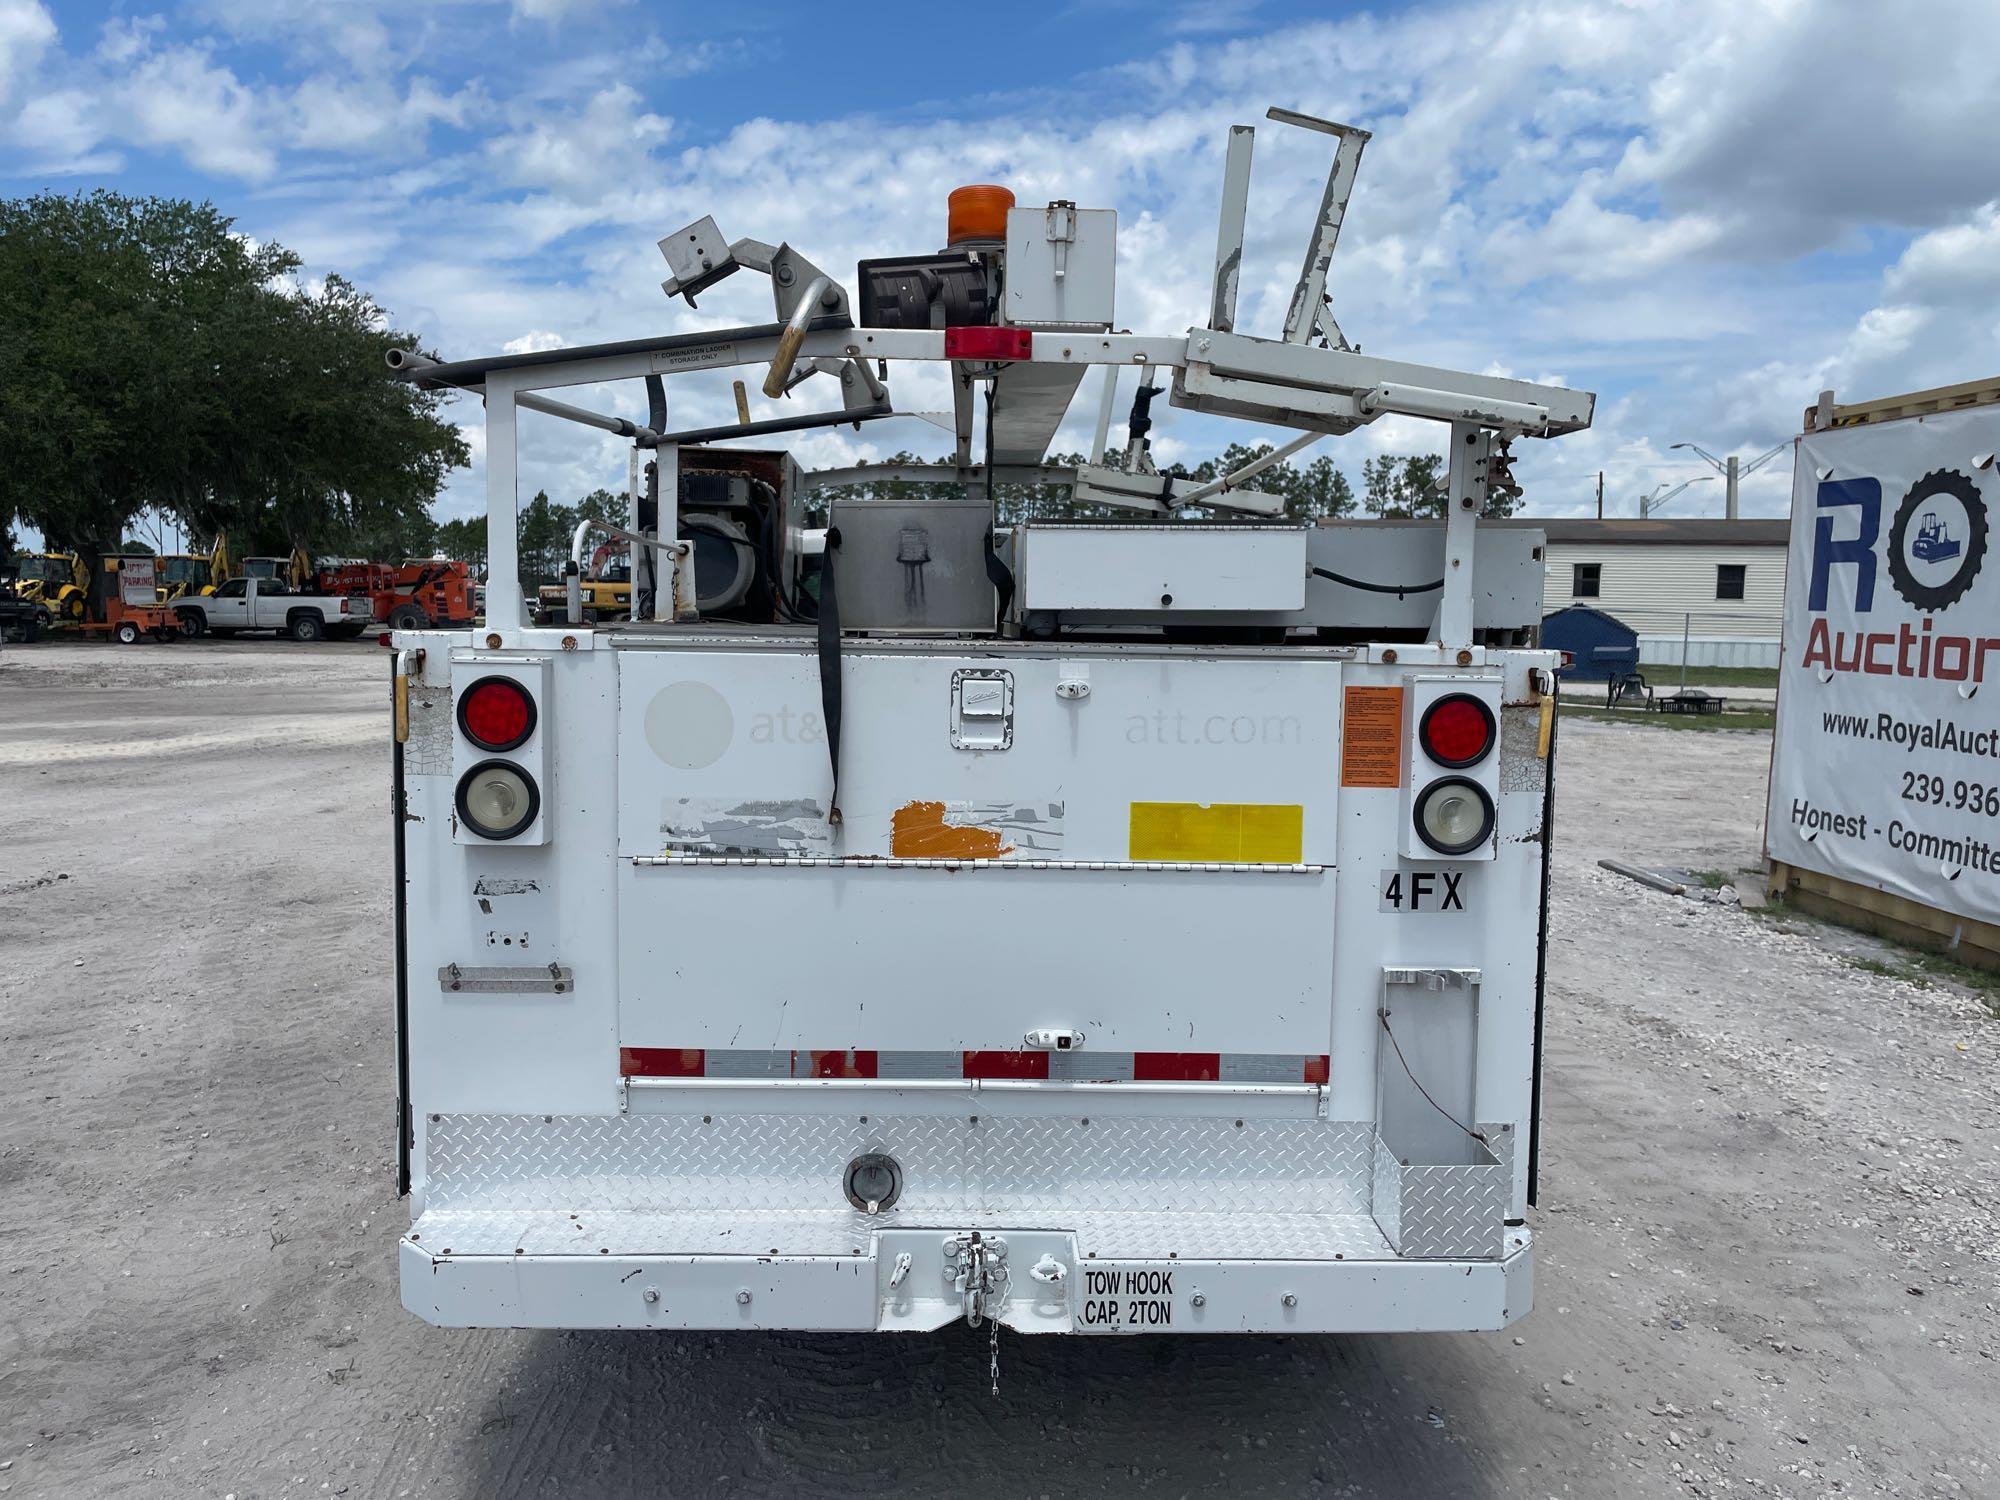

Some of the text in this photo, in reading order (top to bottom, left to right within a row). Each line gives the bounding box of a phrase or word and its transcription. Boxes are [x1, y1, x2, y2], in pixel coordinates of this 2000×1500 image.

[661, 348, 705, 358] COMBINATION
[705, 343, 731, 354] LADDER
[669, 353, 718, 365] STORAGE ONLY
[1125, 709, 1302, 744] att.com
[1791, 798, 1868, 840] Honest
[1085, 1271, 1173, 1295] TOW HOOK
[1085, 1300, 1171, 1325] CAP. 2TON
